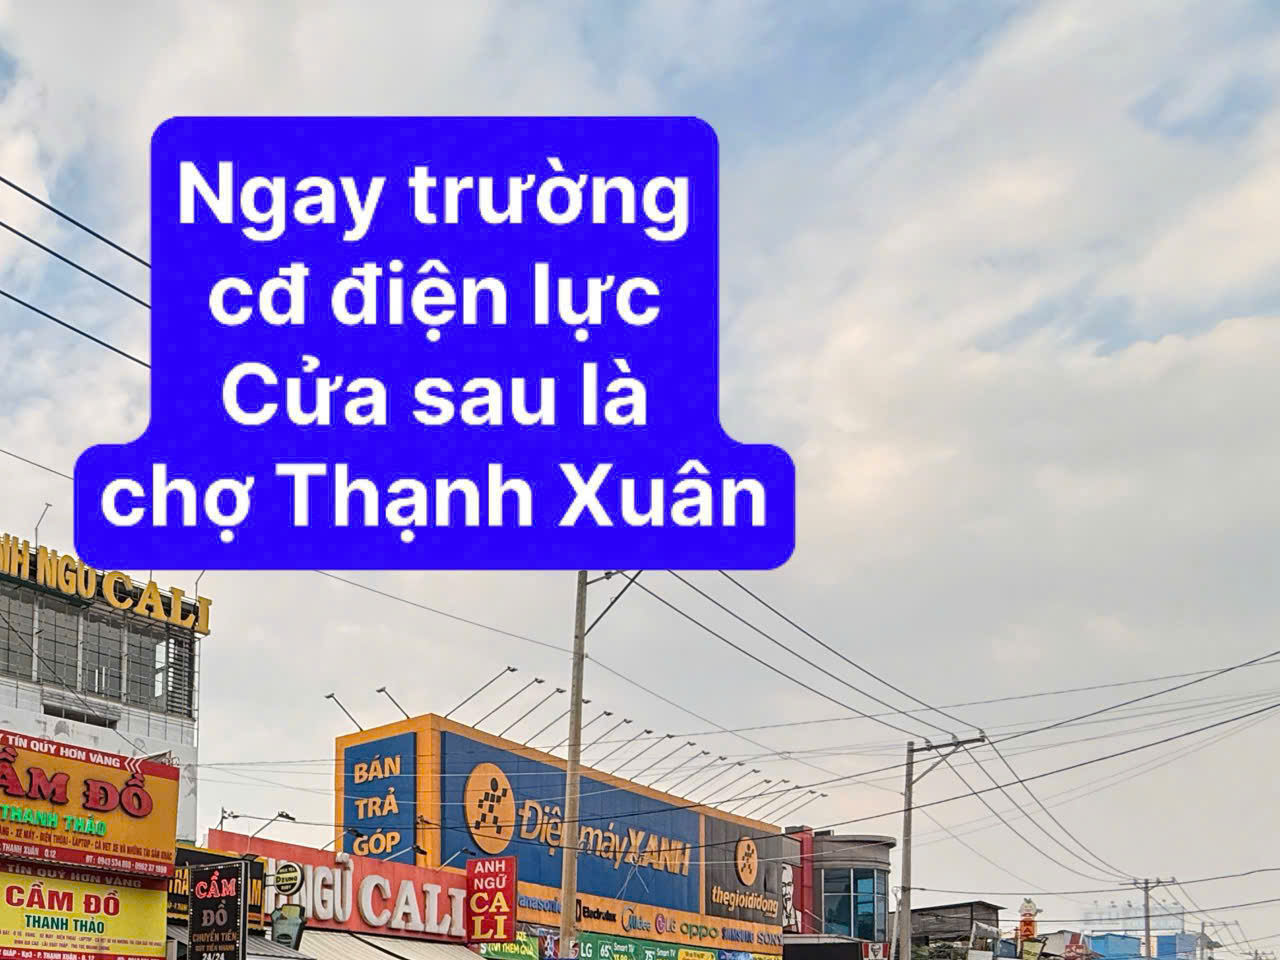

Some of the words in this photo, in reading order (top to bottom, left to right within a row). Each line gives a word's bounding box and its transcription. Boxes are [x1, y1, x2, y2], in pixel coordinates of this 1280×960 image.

[102, 570, 213, 635] CALI
[7, 735, 28, 748] TÍN
[60, 747, 86, 760] HƠN
[89, 753, 121, 767] VÀNG
[353, 754, 401, 784] BÁN
[83, 772, 153, 818] ĐỒ
[354, 787, 399, 820] TRẢ
[0, 804, 59, 828] THANH
[63, 815, 108, 836] THẢO
[518, 799, 564, 856] Điệ
[353, 828, 401, 857] GÓP
[7, 863, 32, 875] TÍN
[71, 871, 101, 883] HƠN
[104, 875, 142, 888] VÀNG
[474, 860, 505, 874] ANH
[5, 881, 74, 912] CẦM
[83, 889, 121, 916] ĐỒ
[195, 870, 237, 899] CẦM
[202, 900, 228, 927] ĐỒ
[359, 875, 466, 937] CALI
[470, 891, 510, 913] CA
[25, 914, 69, 931] THANH
[73, 916, 105, 934] THẢO
[471, 915, 508, 939] LI
[757, 930, 783, 947] SONY
[581, 943, 593, 958] LG
